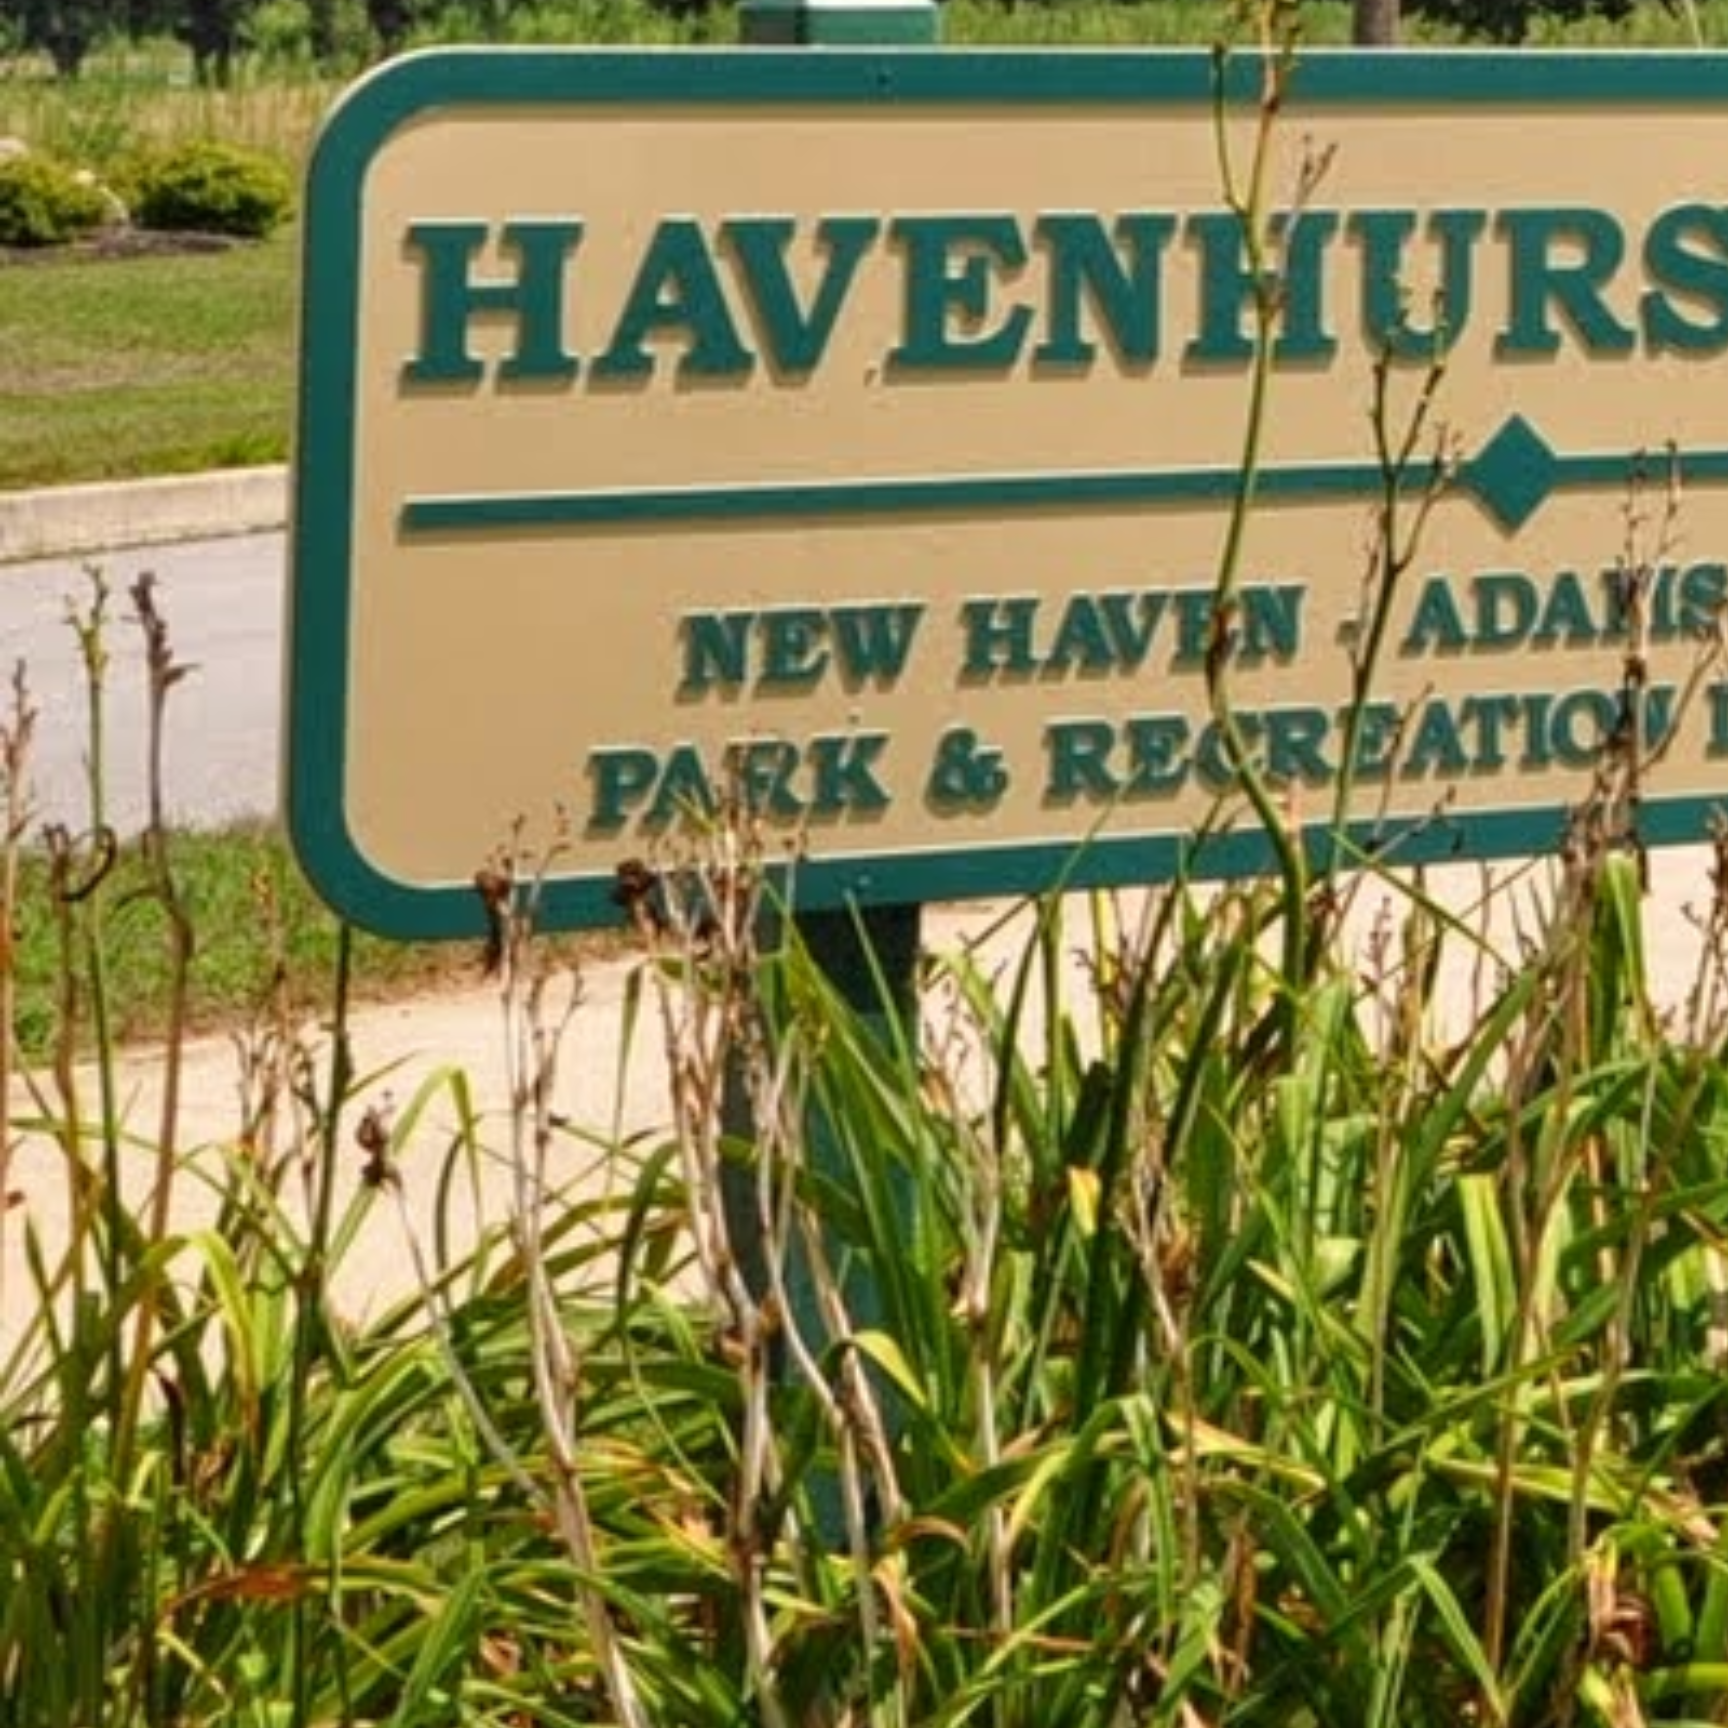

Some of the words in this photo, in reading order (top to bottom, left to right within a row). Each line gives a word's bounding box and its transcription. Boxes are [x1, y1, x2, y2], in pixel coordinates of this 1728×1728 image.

[675, 602, 928, 694] NEW
[957, 583, 1306, 682] HAVEN
[584, 732, 893, 836] PARK
[926, 727, 1009, 817] &
